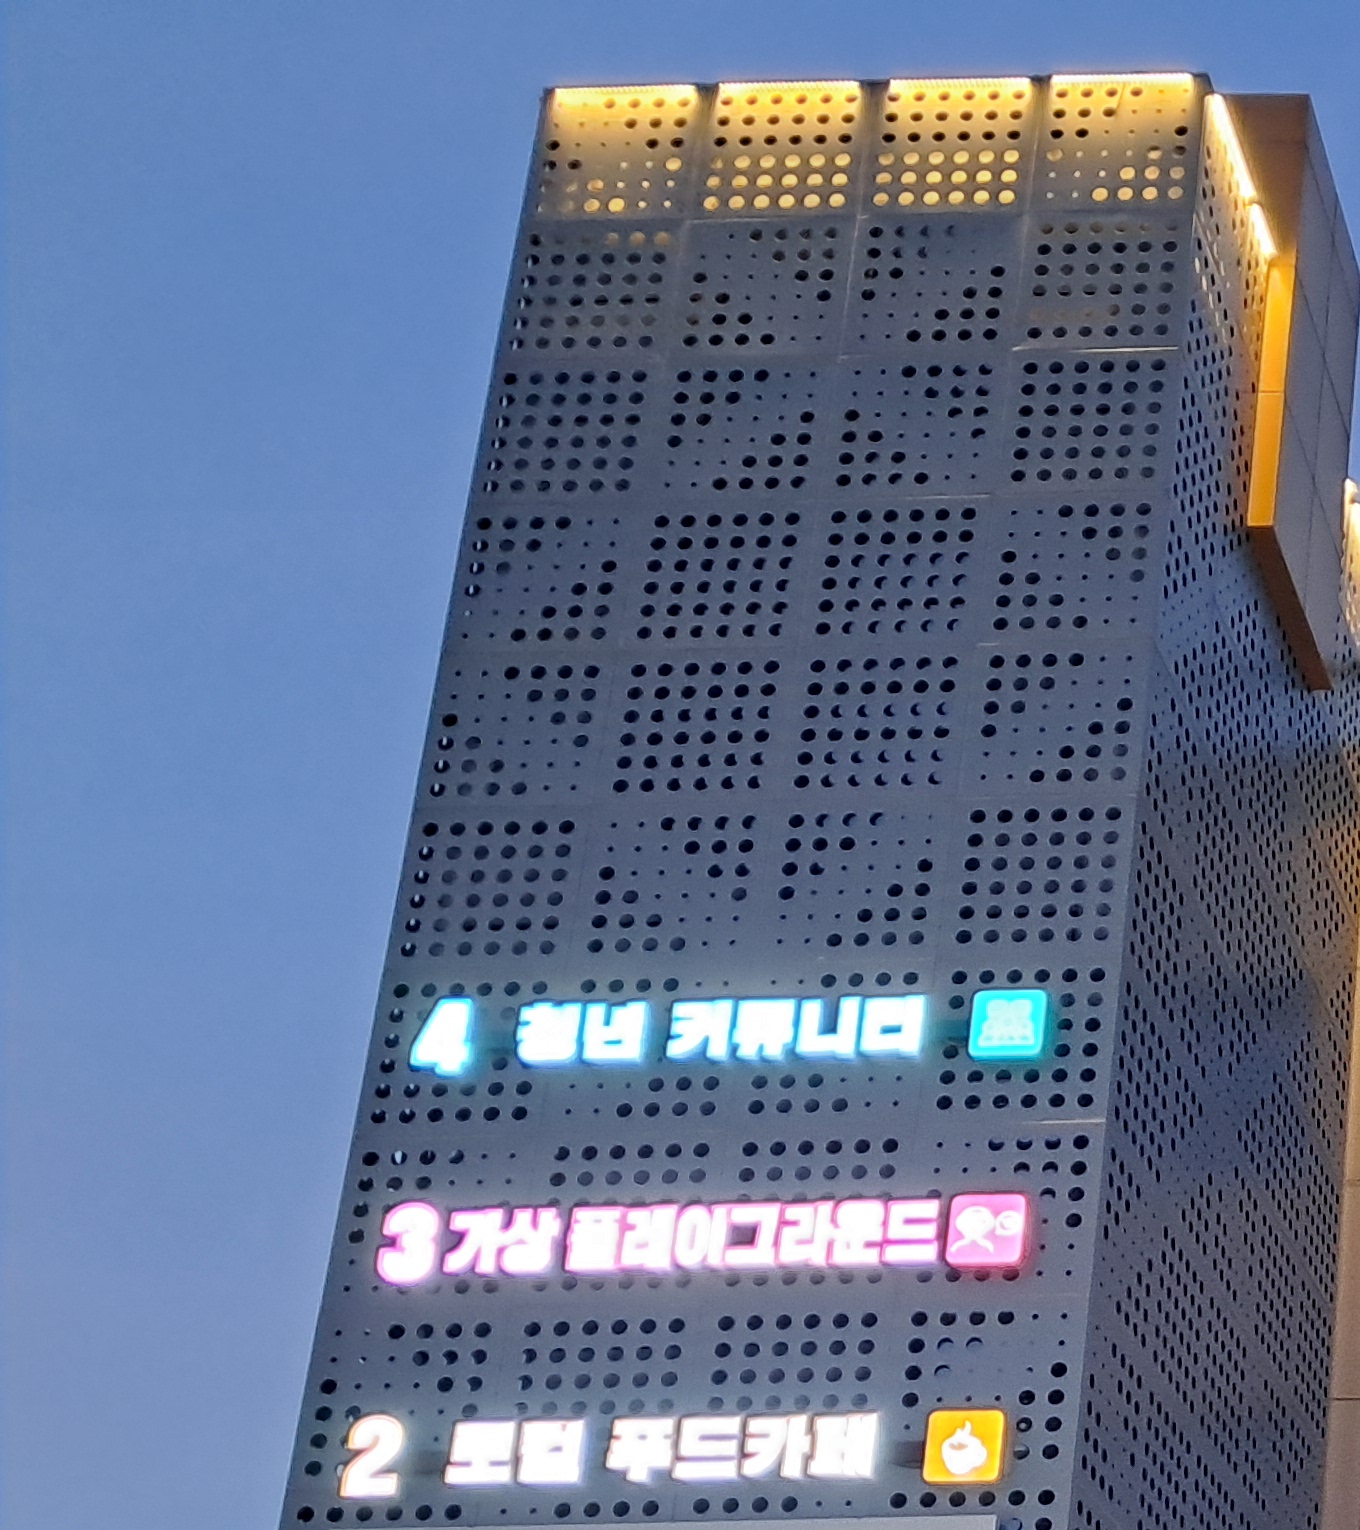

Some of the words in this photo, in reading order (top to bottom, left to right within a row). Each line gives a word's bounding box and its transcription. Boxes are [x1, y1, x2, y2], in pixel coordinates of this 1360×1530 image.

[408, 996, 476, 1077] 4
[374, 1202, 440, 1285] 3
[443, 1206, 562, 1275] 가상
[564, 1199, 940, 1274] 플레이그라운드
[338, 1413, 404, 1498] 2
[604, 1411, 880, 1481] 푸드카페
